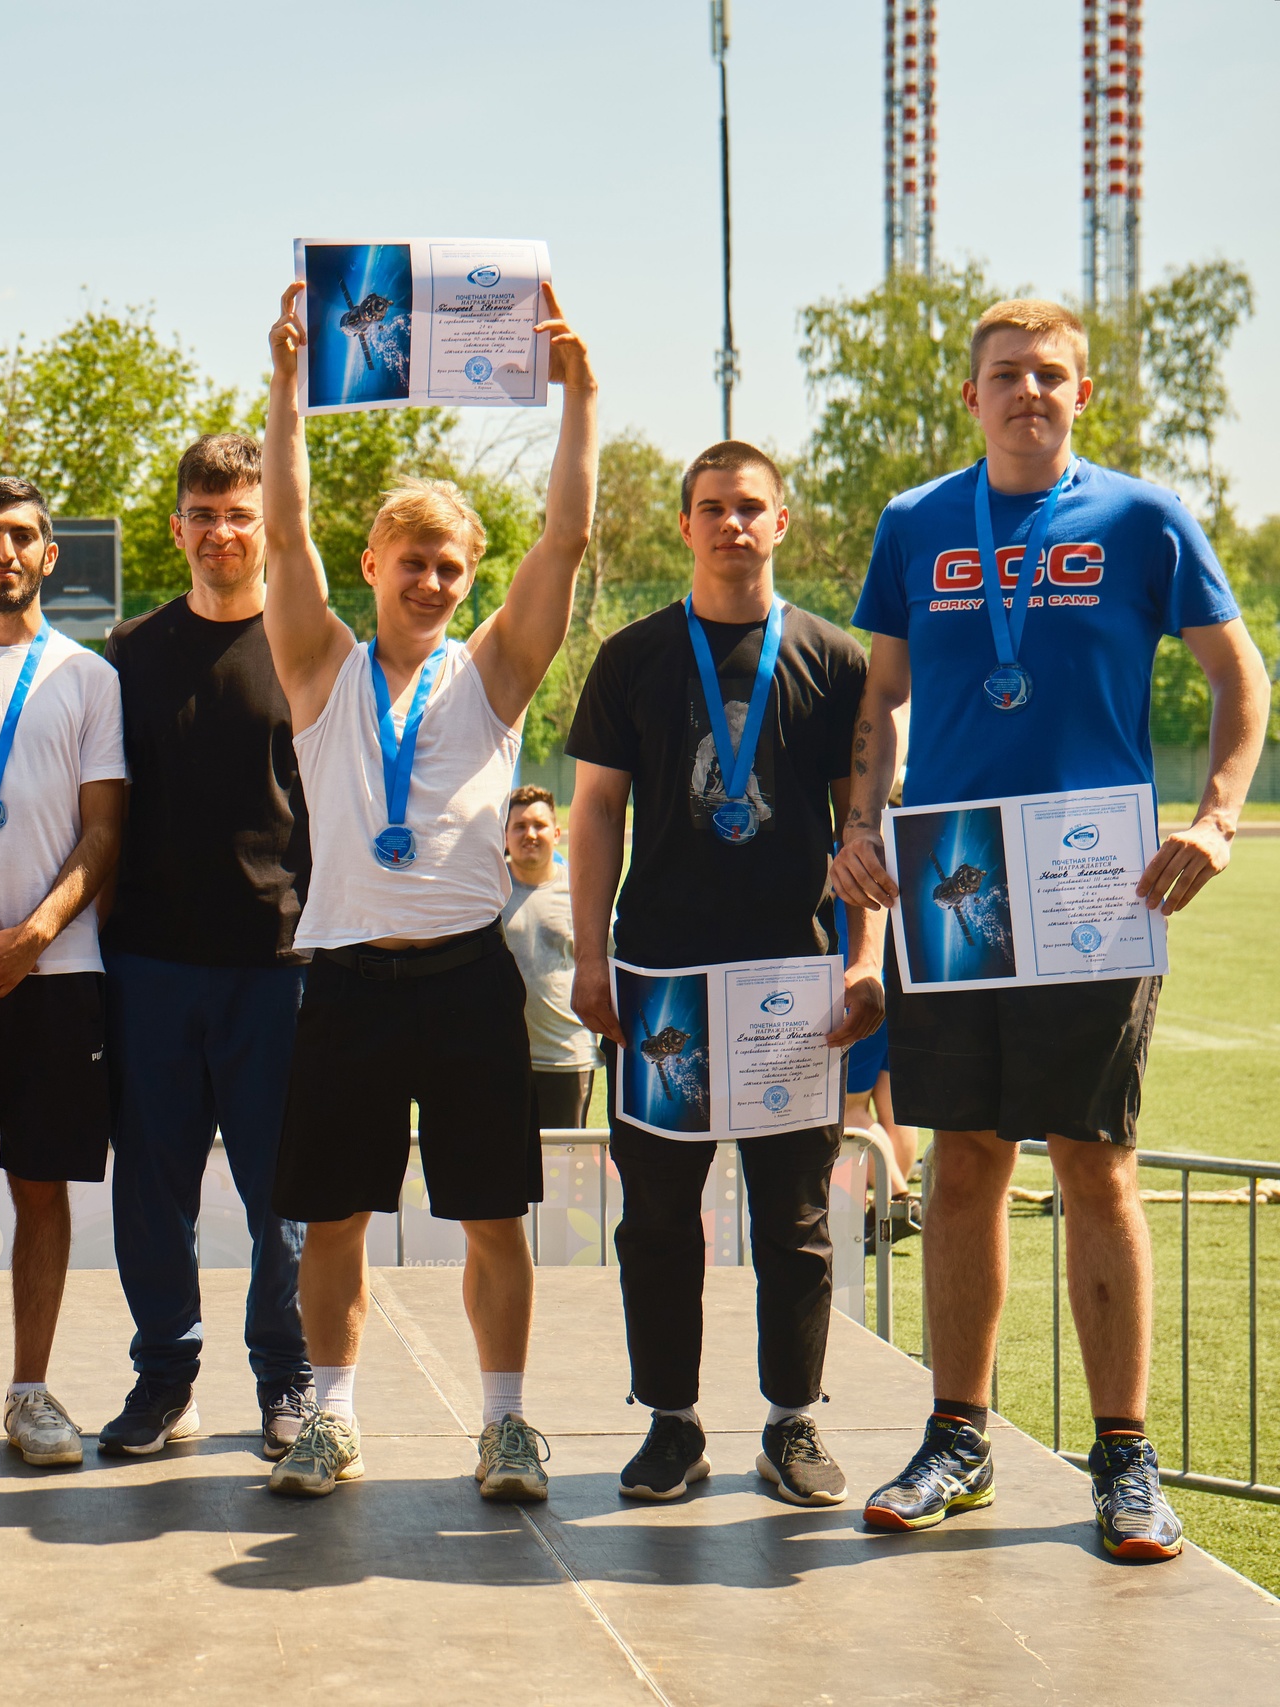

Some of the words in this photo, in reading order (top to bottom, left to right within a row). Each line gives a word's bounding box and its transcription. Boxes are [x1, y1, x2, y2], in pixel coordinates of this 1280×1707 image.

[933, 542, 1105, 592] GCC
[929, 598, 984, 612] GORKY
[1048, 593, 1100, 607] CAMP
[1001, 693, 1011, 707] 3
[731, 825, 740, 839] 2
[392, 850, 400, 863] 1
[1058, 862, 1111, 870] НАГРАЖДАЕТСЯ
[91, 1049, 104, 1061] PU
